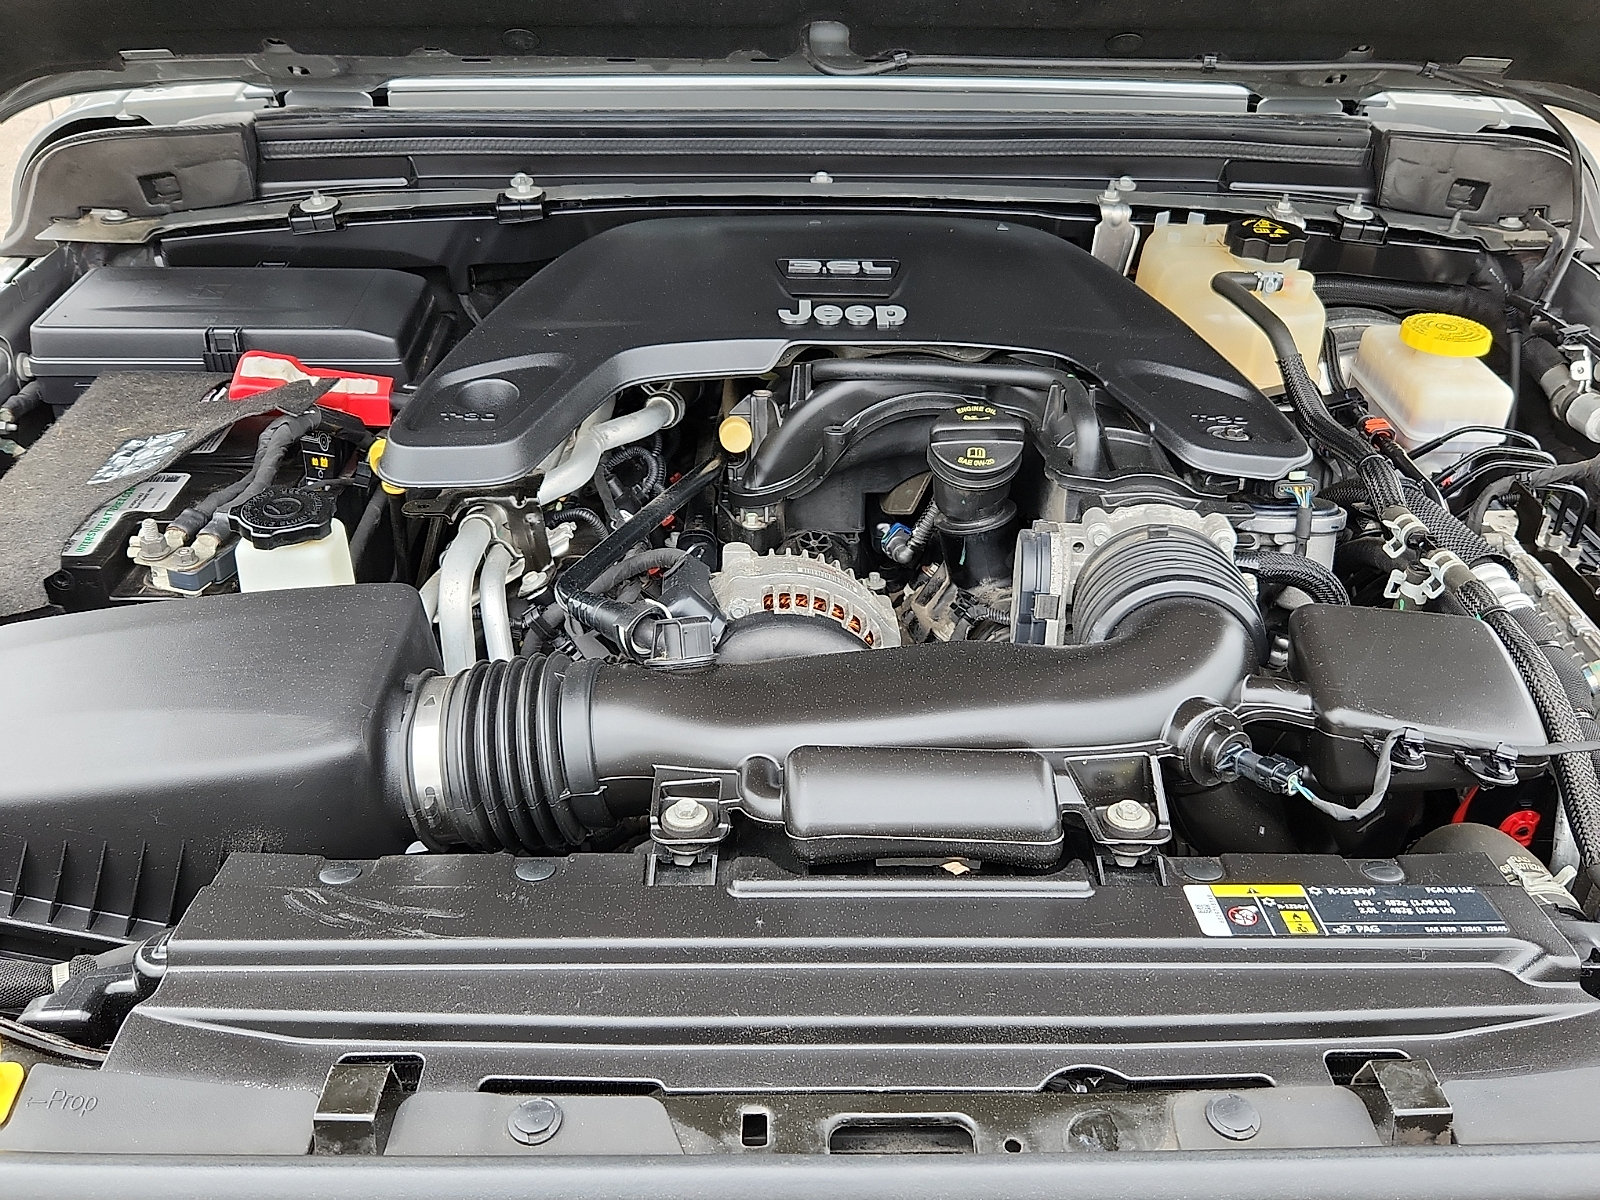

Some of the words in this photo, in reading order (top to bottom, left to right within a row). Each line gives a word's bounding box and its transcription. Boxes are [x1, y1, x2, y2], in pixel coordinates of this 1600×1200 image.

[777, 299, 908, 329] Jeep
[956, 405, 985, 414] ENGINE
[984, 407, 997, 416] OIL
[957, 456, 973, 466] SAE
[1326, 887, 1376, 896] R-1234yf
[1355, 925, 1381, 933] PAG
[47, 1088, 99, 1117] Prop
